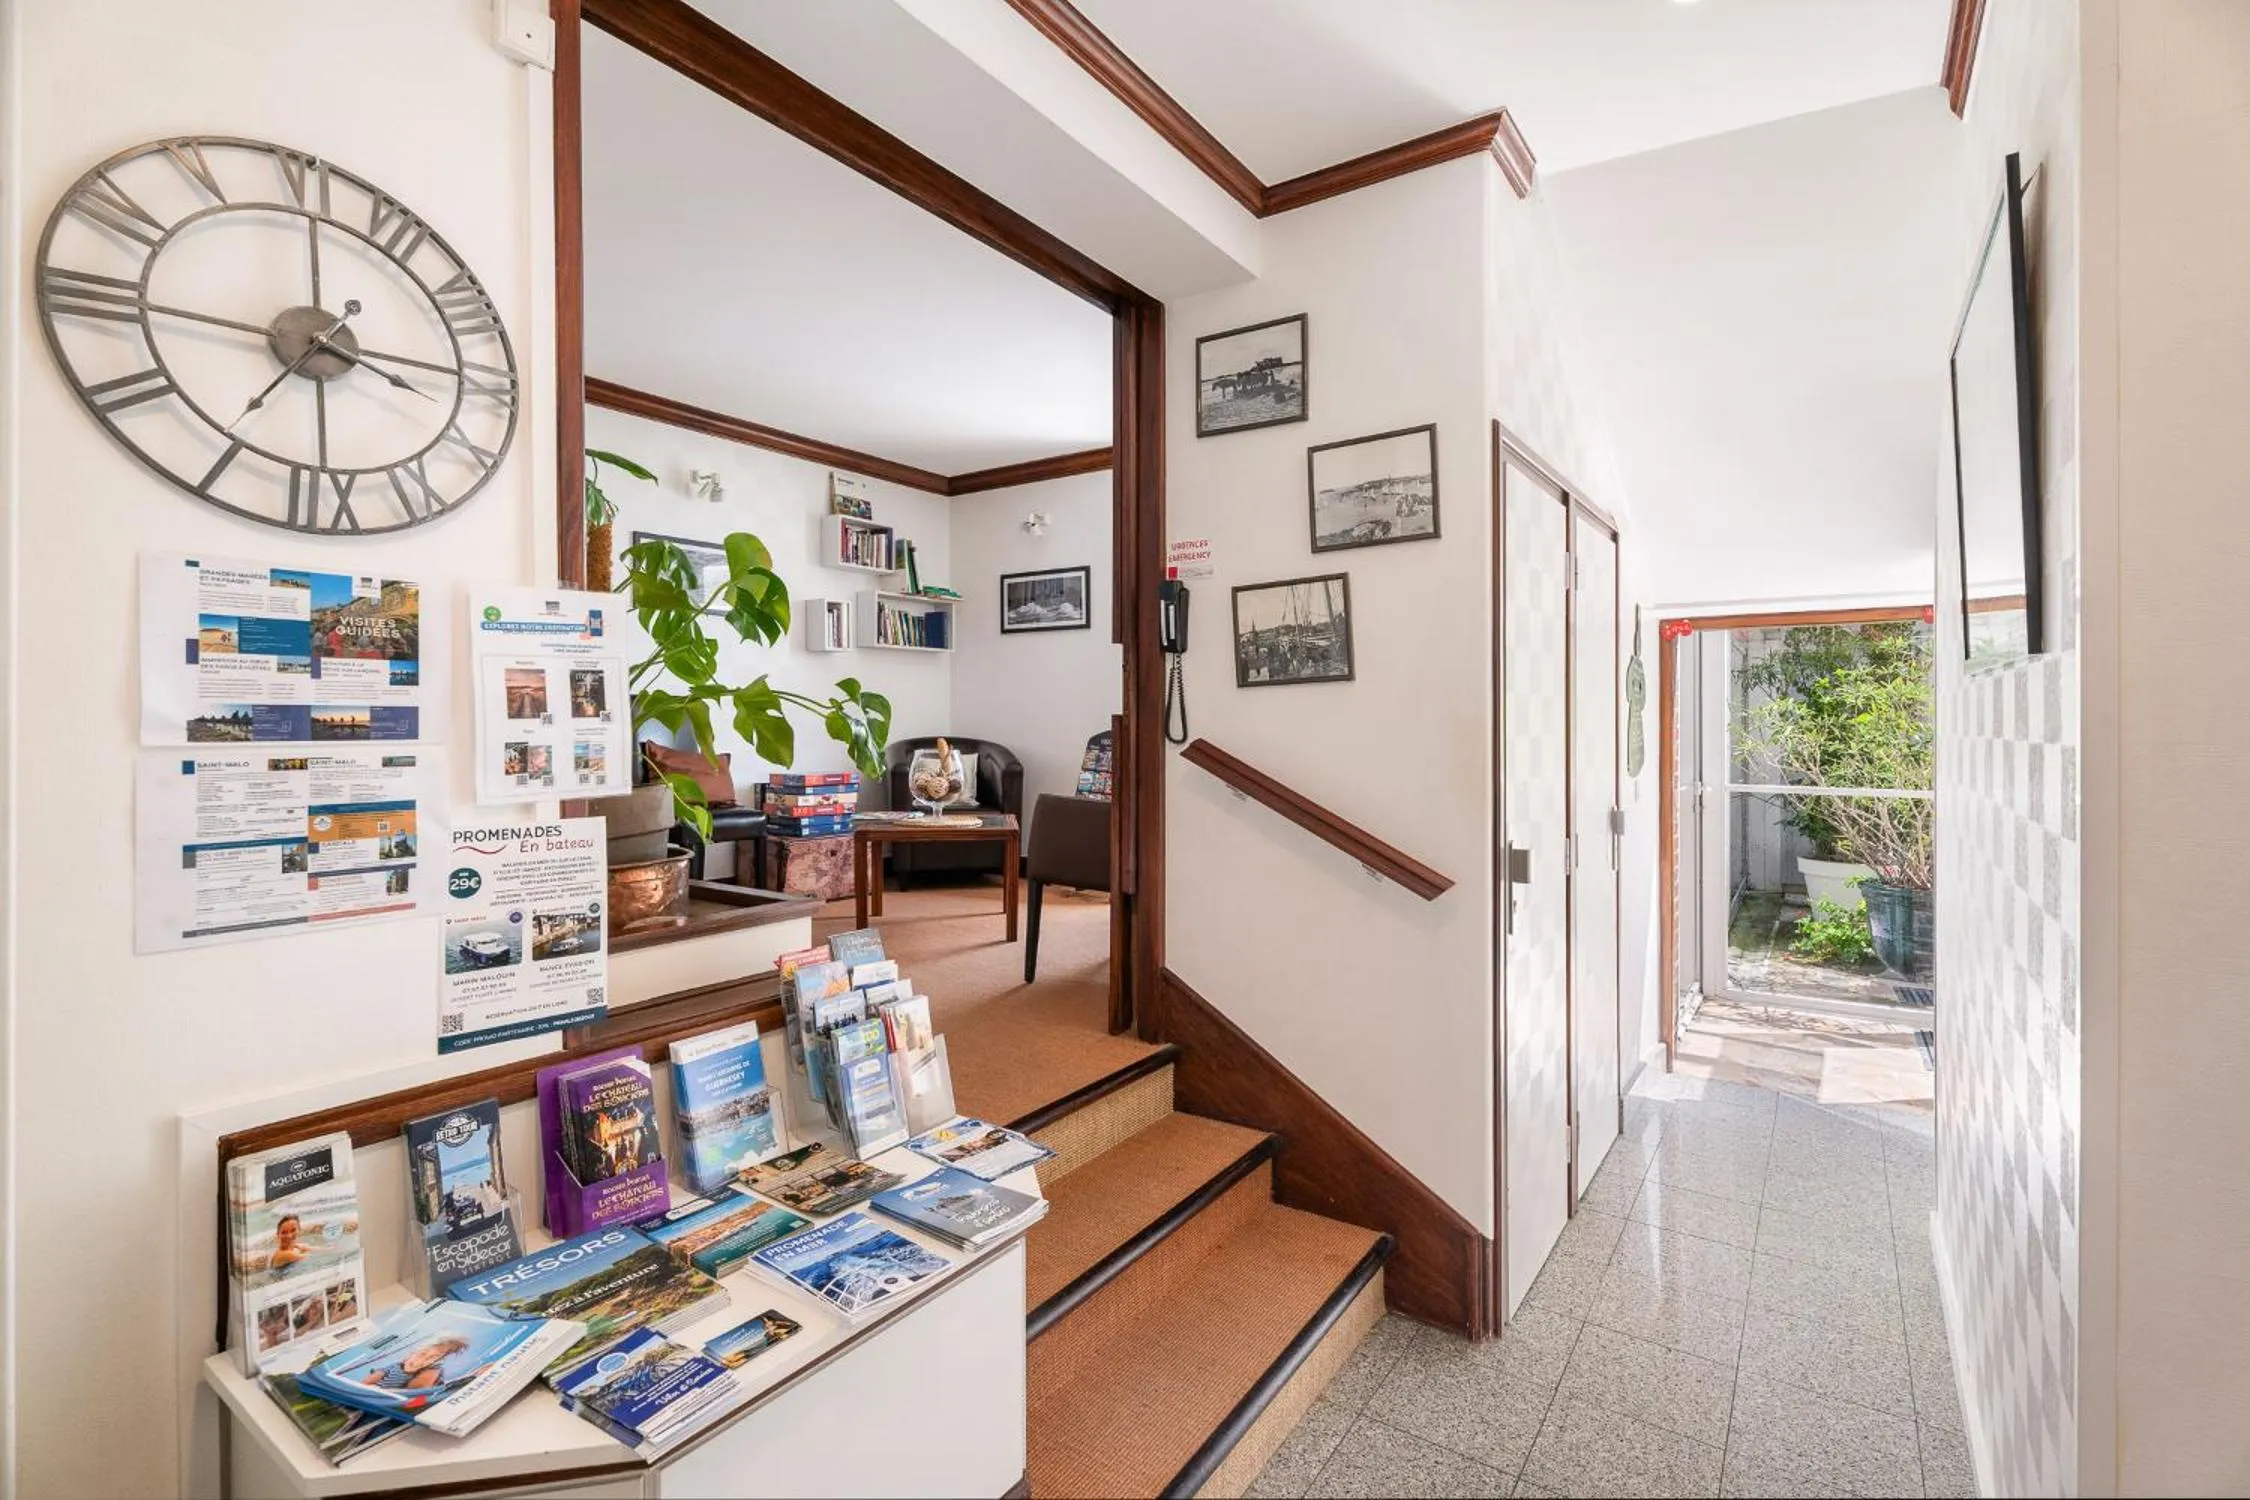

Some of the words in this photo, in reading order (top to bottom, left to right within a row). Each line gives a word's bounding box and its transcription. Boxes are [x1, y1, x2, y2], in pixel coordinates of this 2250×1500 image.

[1167, 551, 1212, 563] EMERGENCY
[339, 615, 397, 629] VISITES
[196, 760, 250, 769] SAINT-MALO
[452, 824, 563, 844] PROMENADES
[519, 839, 540, 853] En
[546, 837, 595, 852] bateau
[449, 876, 481, 891] 29€
[269, 1163, 330, 1189] AQUATONIC
[432, 1222, 510, 1262] Escapade
[765, 1219, 846, 1257] PROMENADE
[437, 1259, 456, 1273] en
[456, 1239, 511, 1269] Sidecar
[467, 1230, 628, 1296] TRÉSORS
